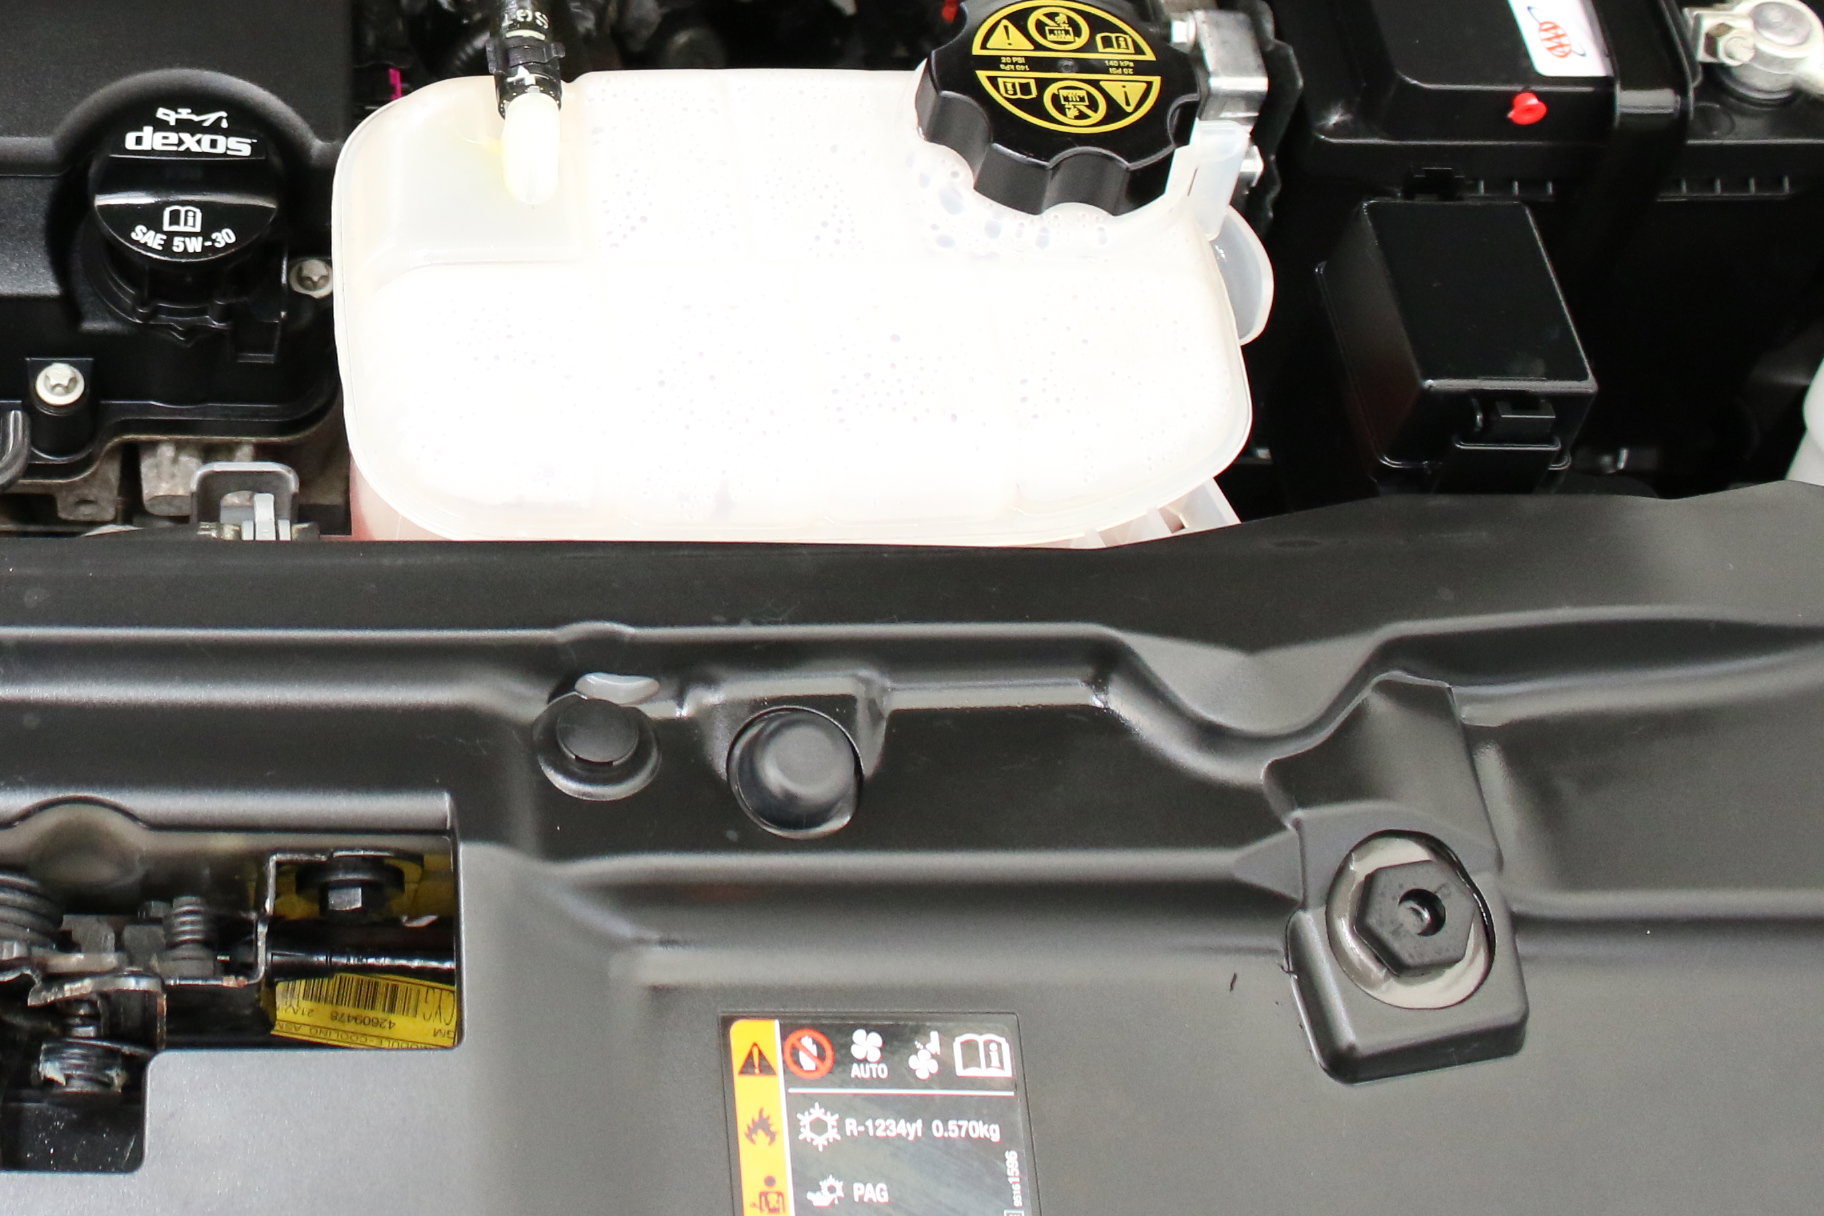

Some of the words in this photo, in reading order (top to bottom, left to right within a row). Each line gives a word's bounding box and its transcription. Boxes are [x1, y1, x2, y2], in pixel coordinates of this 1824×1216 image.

[124, 125, 253, 157] dexos
[130, 224, 168, 251] SAE
[171, 227, 237, 253] 5W-30
[850, 1062, 889, 1080] AUTO
[845, 1118, 923, 1141] R-1234yf
[931, 1119, 1001, 1142] 0.570kg
[853, 1182, 889, 1204] PAG
